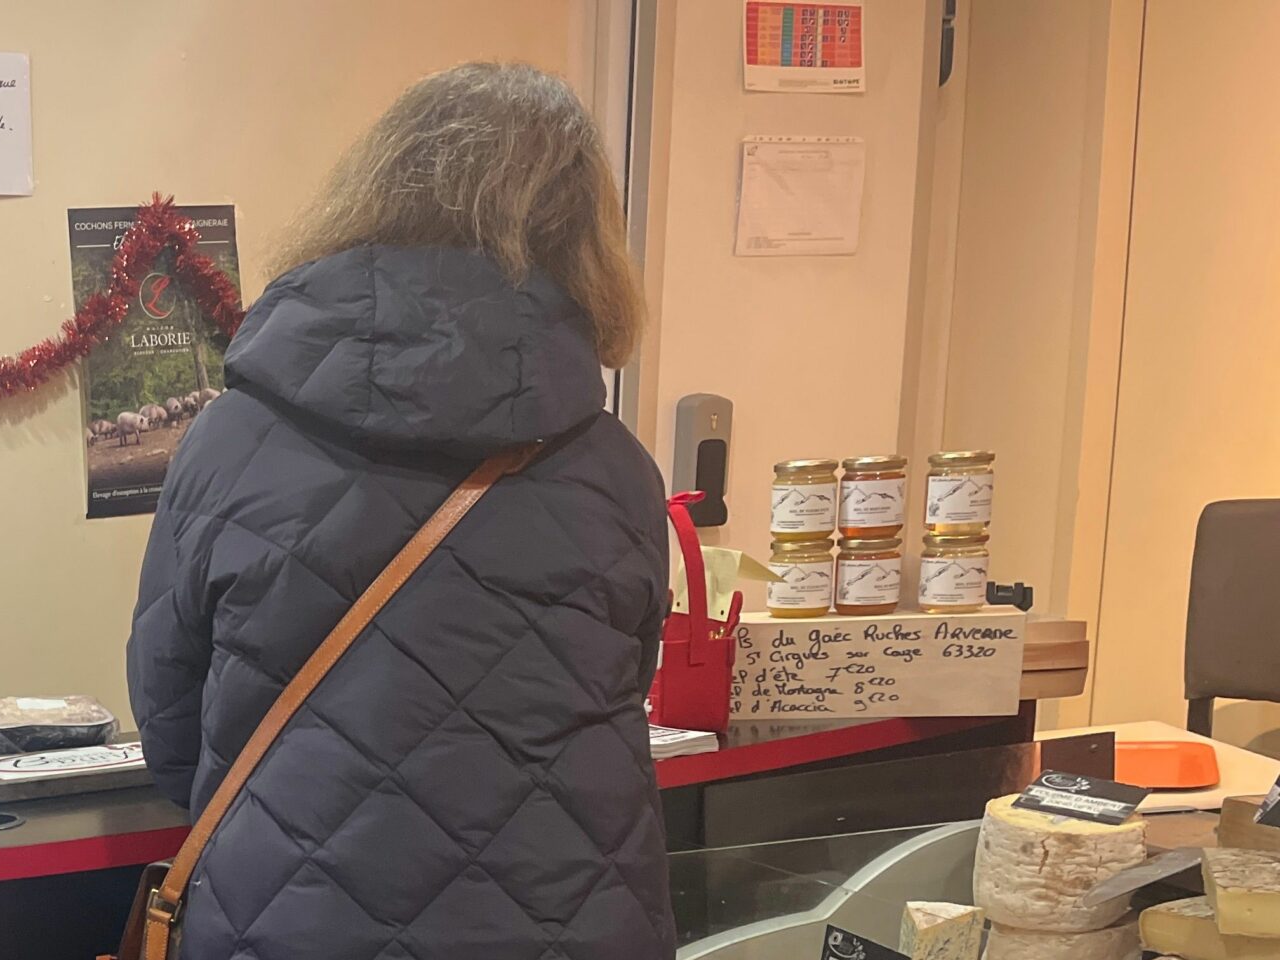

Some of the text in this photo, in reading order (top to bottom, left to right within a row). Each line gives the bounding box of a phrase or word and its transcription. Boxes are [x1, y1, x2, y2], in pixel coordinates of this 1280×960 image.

[75, 222, 113, 231] COCHONS
[131, 332, 191, 348] LABORIE
[771, 629, 796, 648] du
[863, 624, 922, 642] Ruches
[942, 643, 997, 659] 63320
[751, 683, 772, 697] de
